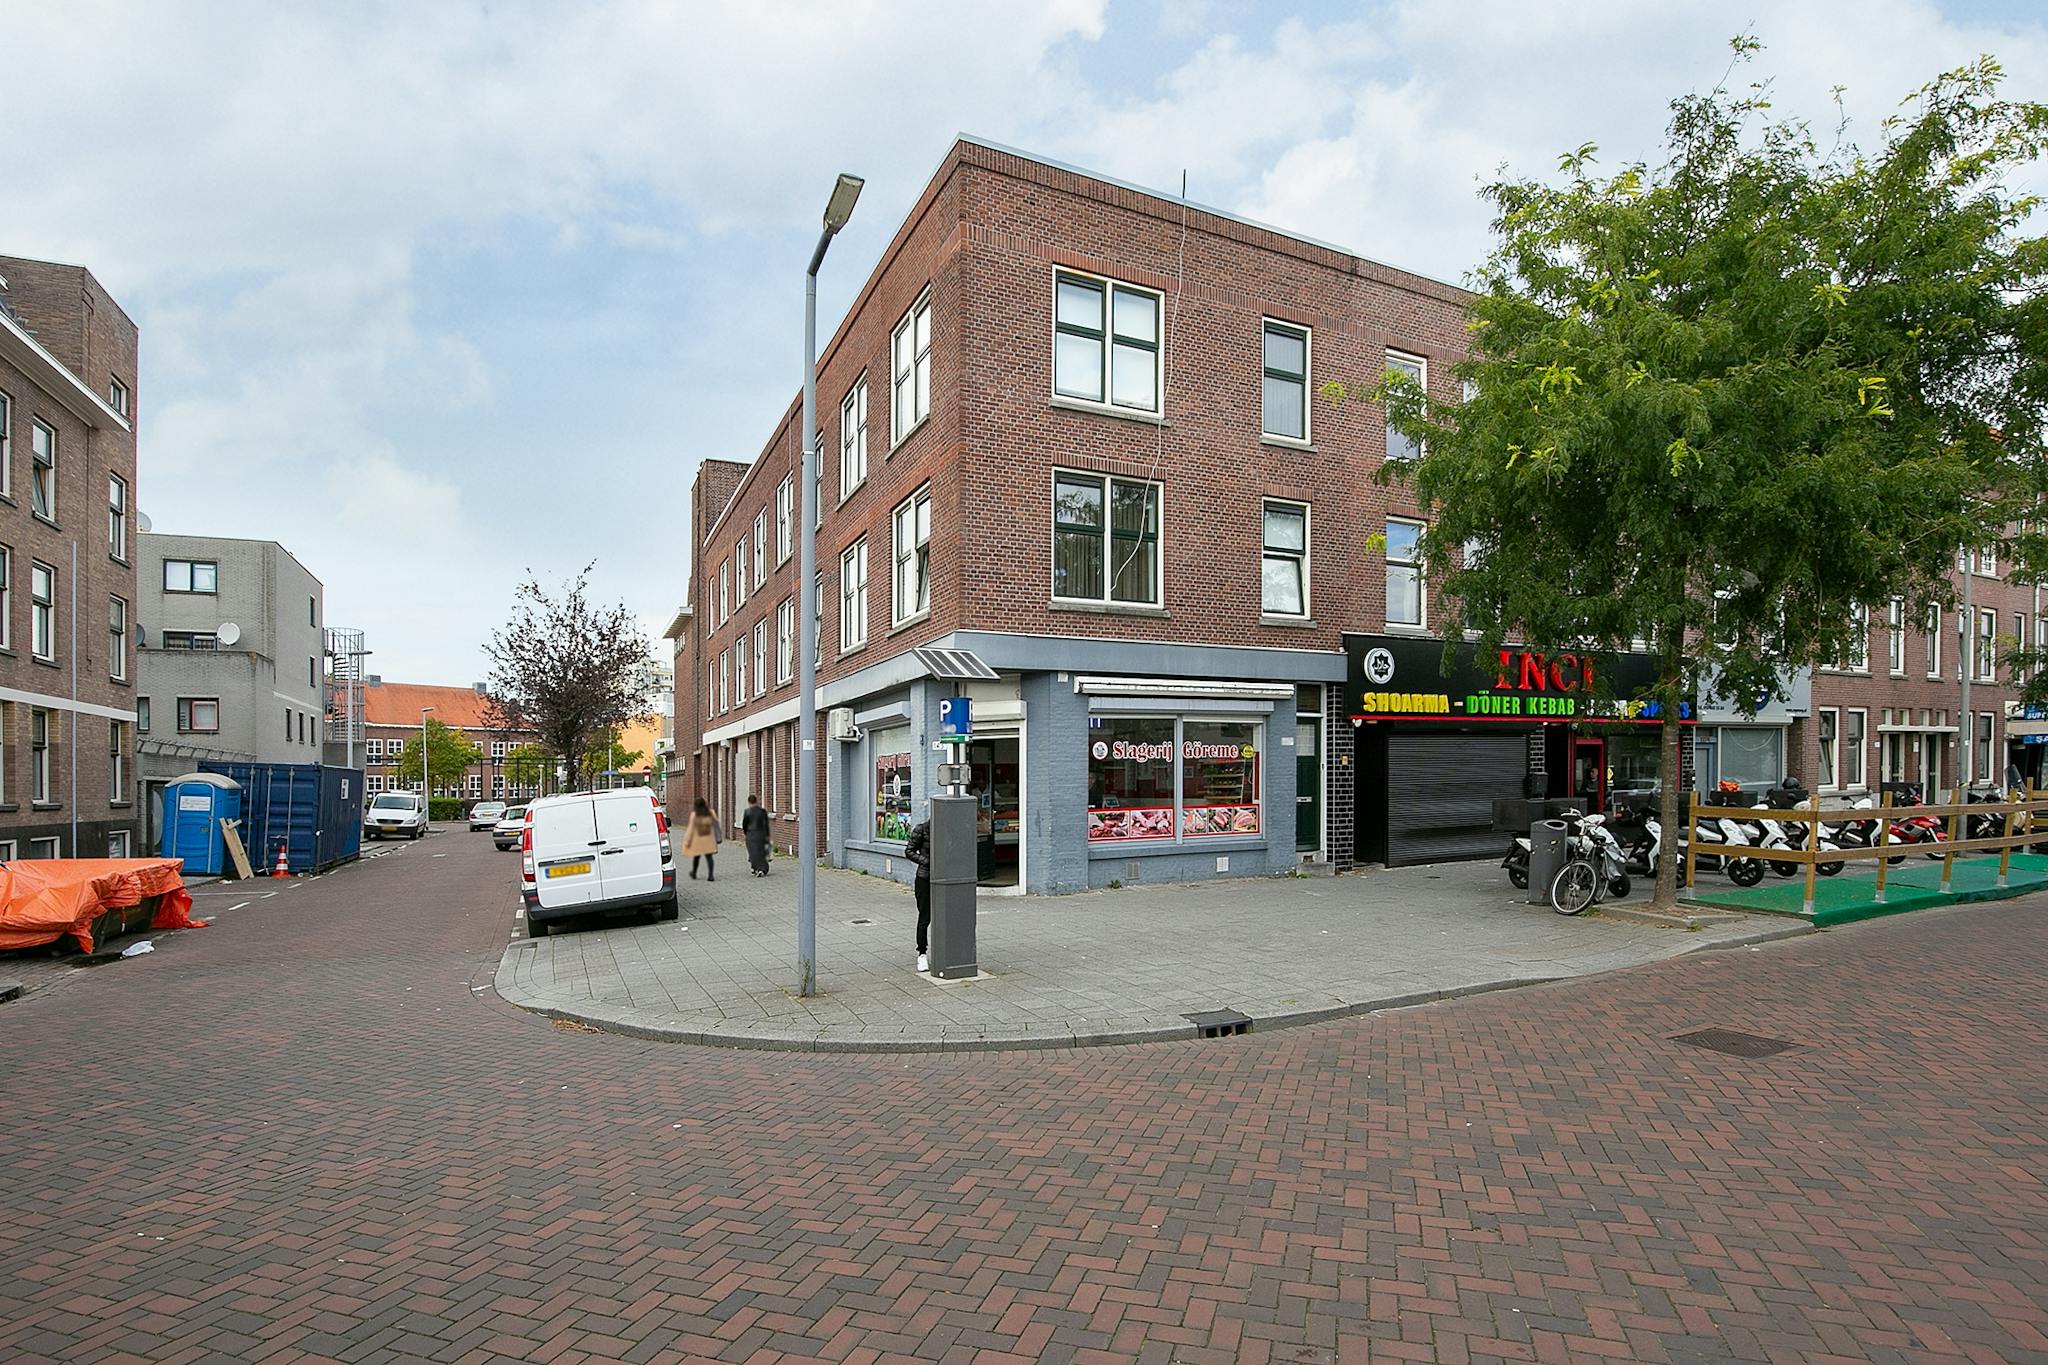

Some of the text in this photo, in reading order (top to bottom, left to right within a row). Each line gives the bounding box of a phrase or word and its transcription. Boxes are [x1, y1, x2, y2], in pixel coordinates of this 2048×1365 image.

[940, 700, 952, 722] P
[1363, 692, 1450, 713] SHOARMA
[1466, 690, 1520, 715] DÖNER
[1526, 697, 1575, 715] KEBAB
[1112, 741, 1239, 762] Slagerij Göreme
